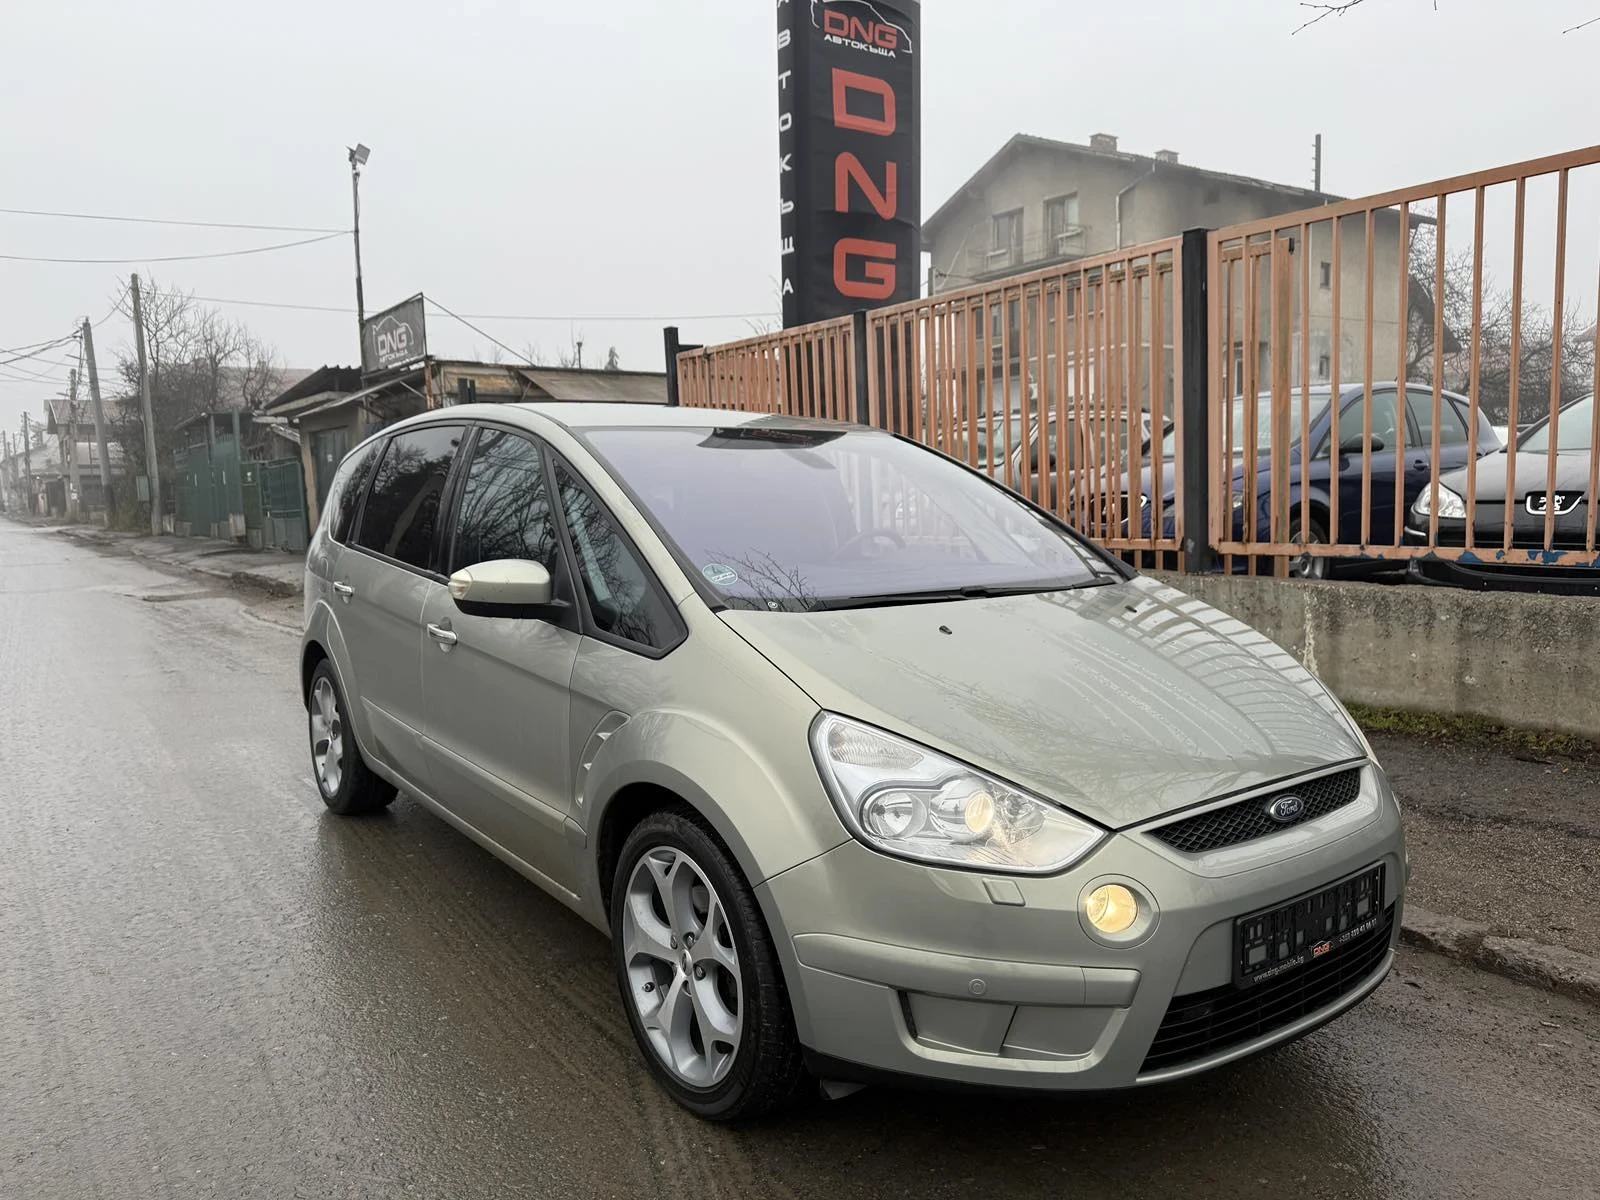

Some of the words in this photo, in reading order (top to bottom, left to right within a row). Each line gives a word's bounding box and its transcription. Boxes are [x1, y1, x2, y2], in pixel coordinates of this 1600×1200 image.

[824, 9, 897, 49] DNG
[832, 67, 896, 300] DNG
[378, 326, 407, 356] DNG
[1280, 799, 1299, 816] Ford
